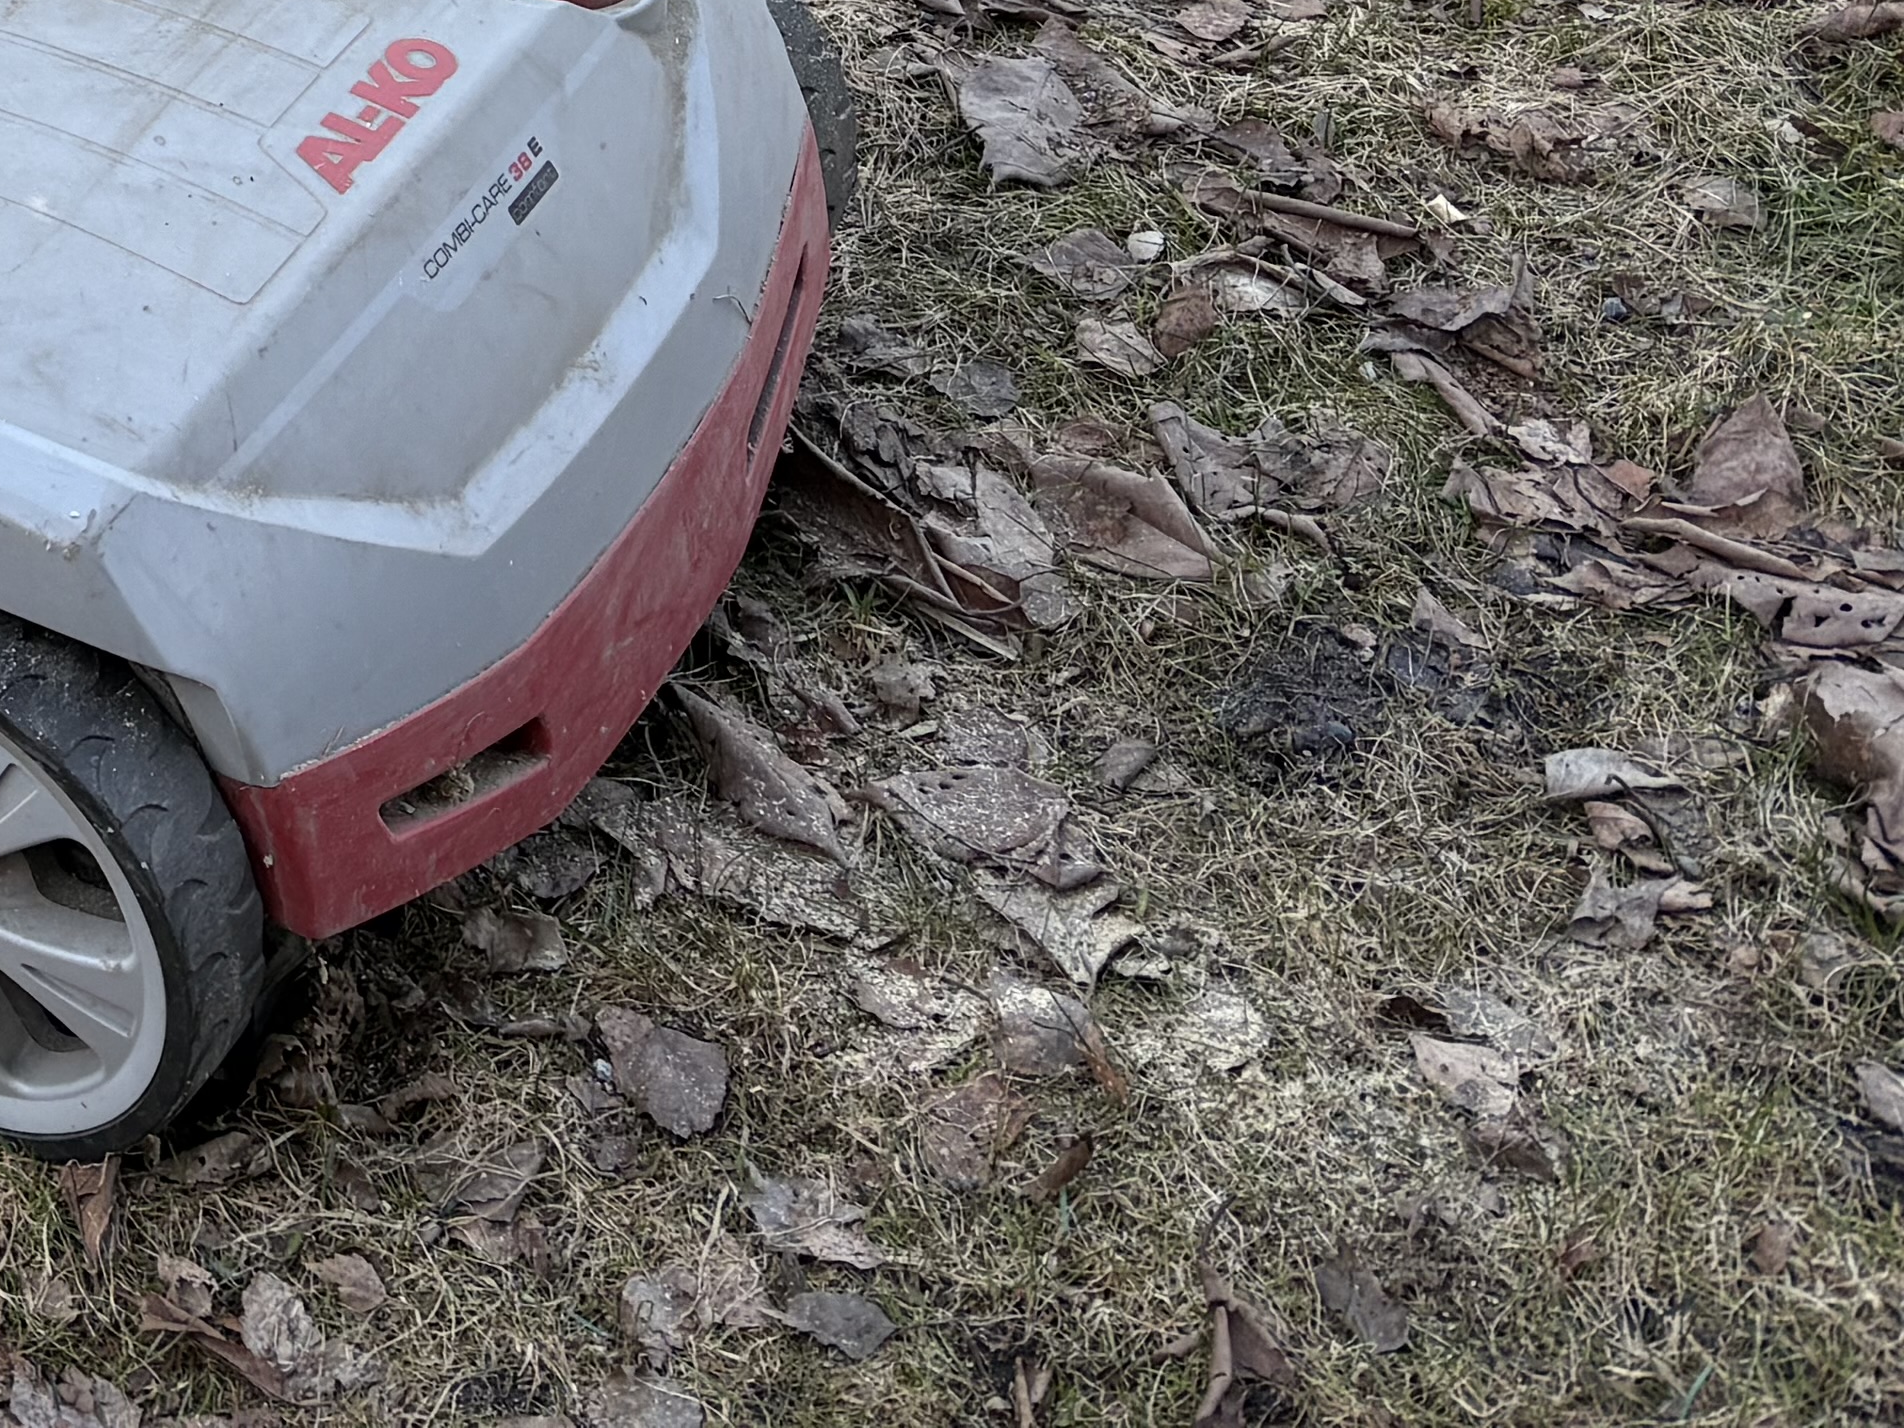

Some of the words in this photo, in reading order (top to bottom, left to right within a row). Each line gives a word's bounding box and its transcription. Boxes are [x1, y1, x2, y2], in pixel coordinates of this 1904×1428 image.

[296, 38, 459, 195] AL-KO
[423, 173, 522, 279] COMBI-CARE
[508, 151, 533, 182] 38
[527, 136, 543, 157] E
